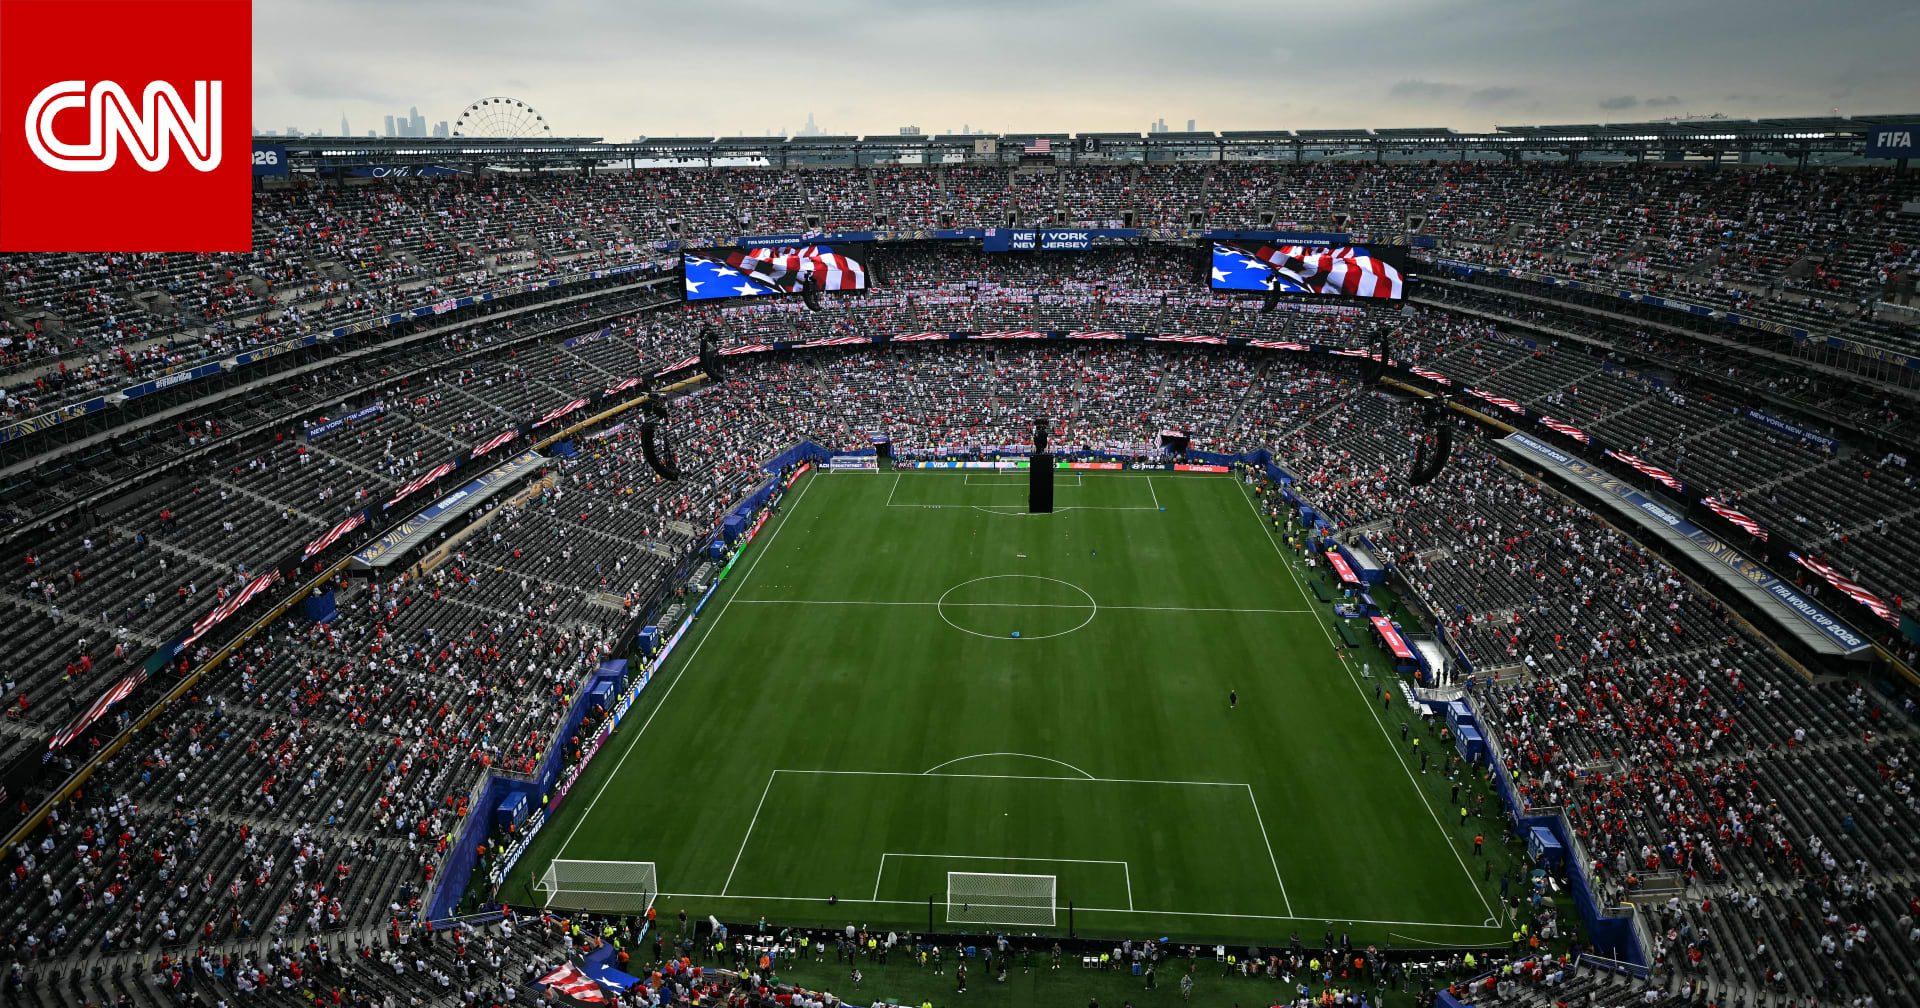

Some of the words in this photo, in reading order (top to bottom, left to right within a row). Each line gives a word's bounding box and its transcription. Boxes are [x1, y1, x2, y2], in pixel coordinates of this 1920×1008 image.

[1877, 132, 1911, 147] FIFA
[310, 426, 326, 436] NEW
[326, 419, 344, 430] YORK
[1750, 411, 1765, 421] NEW
[1766, 417, 1785, 428] YORK
[1785, 424, 1802, 435] NEW
[1802, 432, 1833, 446] JERSEY
[1524, 438, 1541, 451] WORLD
[1539, 447, 1550, 455] CUP
[1772, 585, 1791, 599] FIFA
[1787, 594, 1817, 616] WORLD
[1812, 613, 1833, 628] CUP
[1827, 624, 1861, 646] 2026
[617, 701, 629, 720] VISA
[561, 770, 579, 796] QATAR
[579, 743, 599, 773] AIRWAYS
[504, 814, 545, 877] PREDICTSTREET
